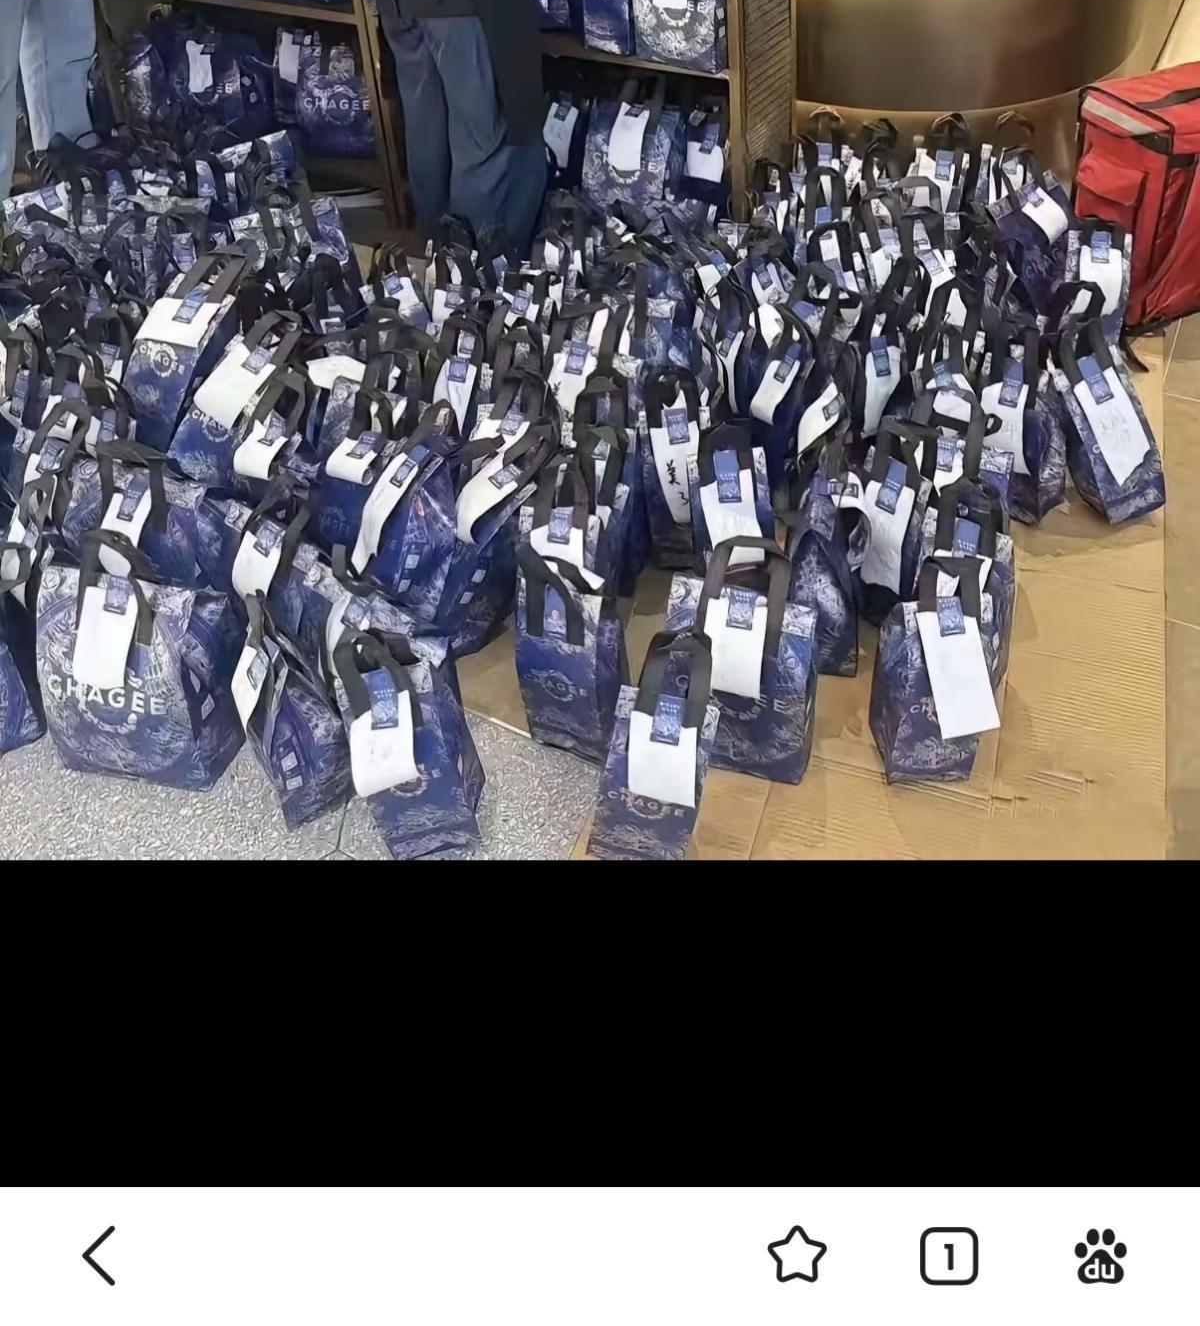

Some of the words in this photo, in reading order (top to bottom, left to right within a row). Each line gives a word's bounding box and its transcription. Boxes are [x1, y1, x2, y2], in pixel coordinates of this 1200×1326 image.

[303, 97, 370, 111] CHAGEE
[139, 343, 185, 375] CHAGEE
[47, 674, 167, 715] CHAGEE
